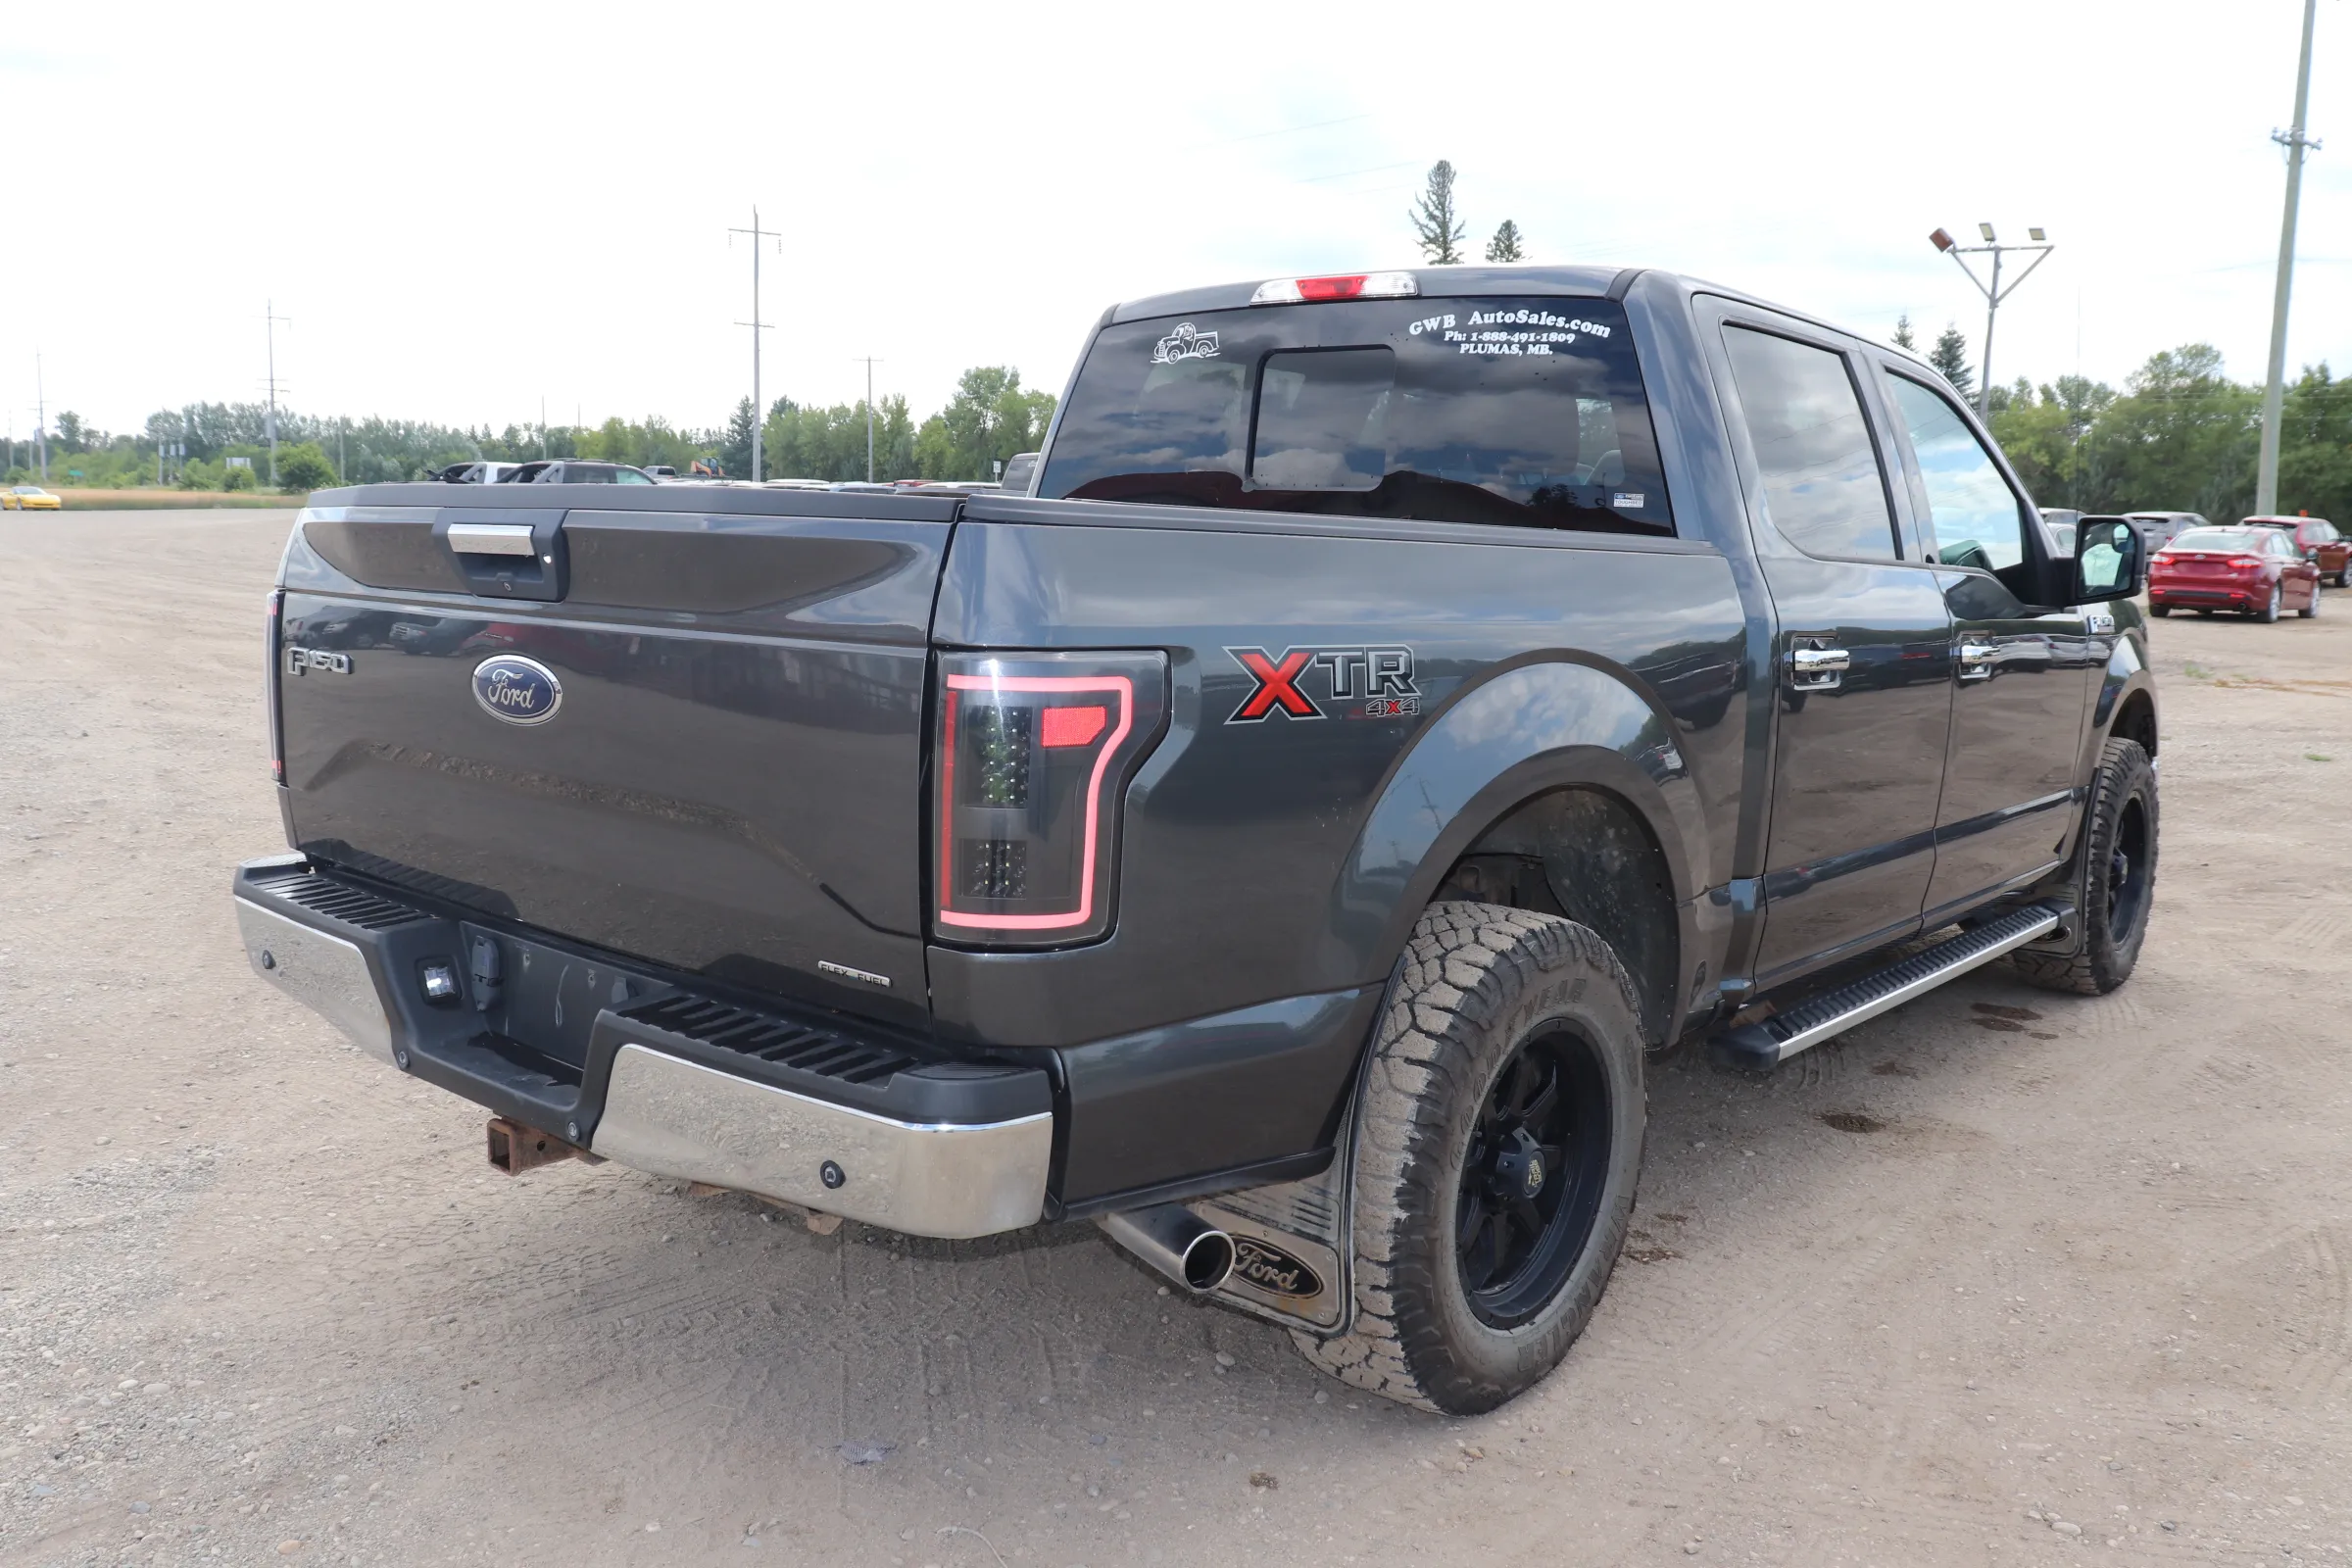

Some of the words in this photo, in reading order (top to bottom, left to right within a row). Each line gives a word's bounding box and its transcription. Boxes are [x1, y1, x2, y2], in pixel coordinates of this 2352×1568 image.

[1409, 315, 1456, 335] GWB
[1468, 310, 1611, 338] AutoSales.com
[1444, 331, 1467, 341] Ph:
[1471, 331, 1576, 343] 1-888-491-1809
[1459, 343, 1523, 356] PLUMAS,
[1527, 344, 1553, 355] MB.
[488, 668, 536, 709] Ford
[1222, 644, 1422, 724] XTR
[1234, 1242, 1299, 1290] Ford
